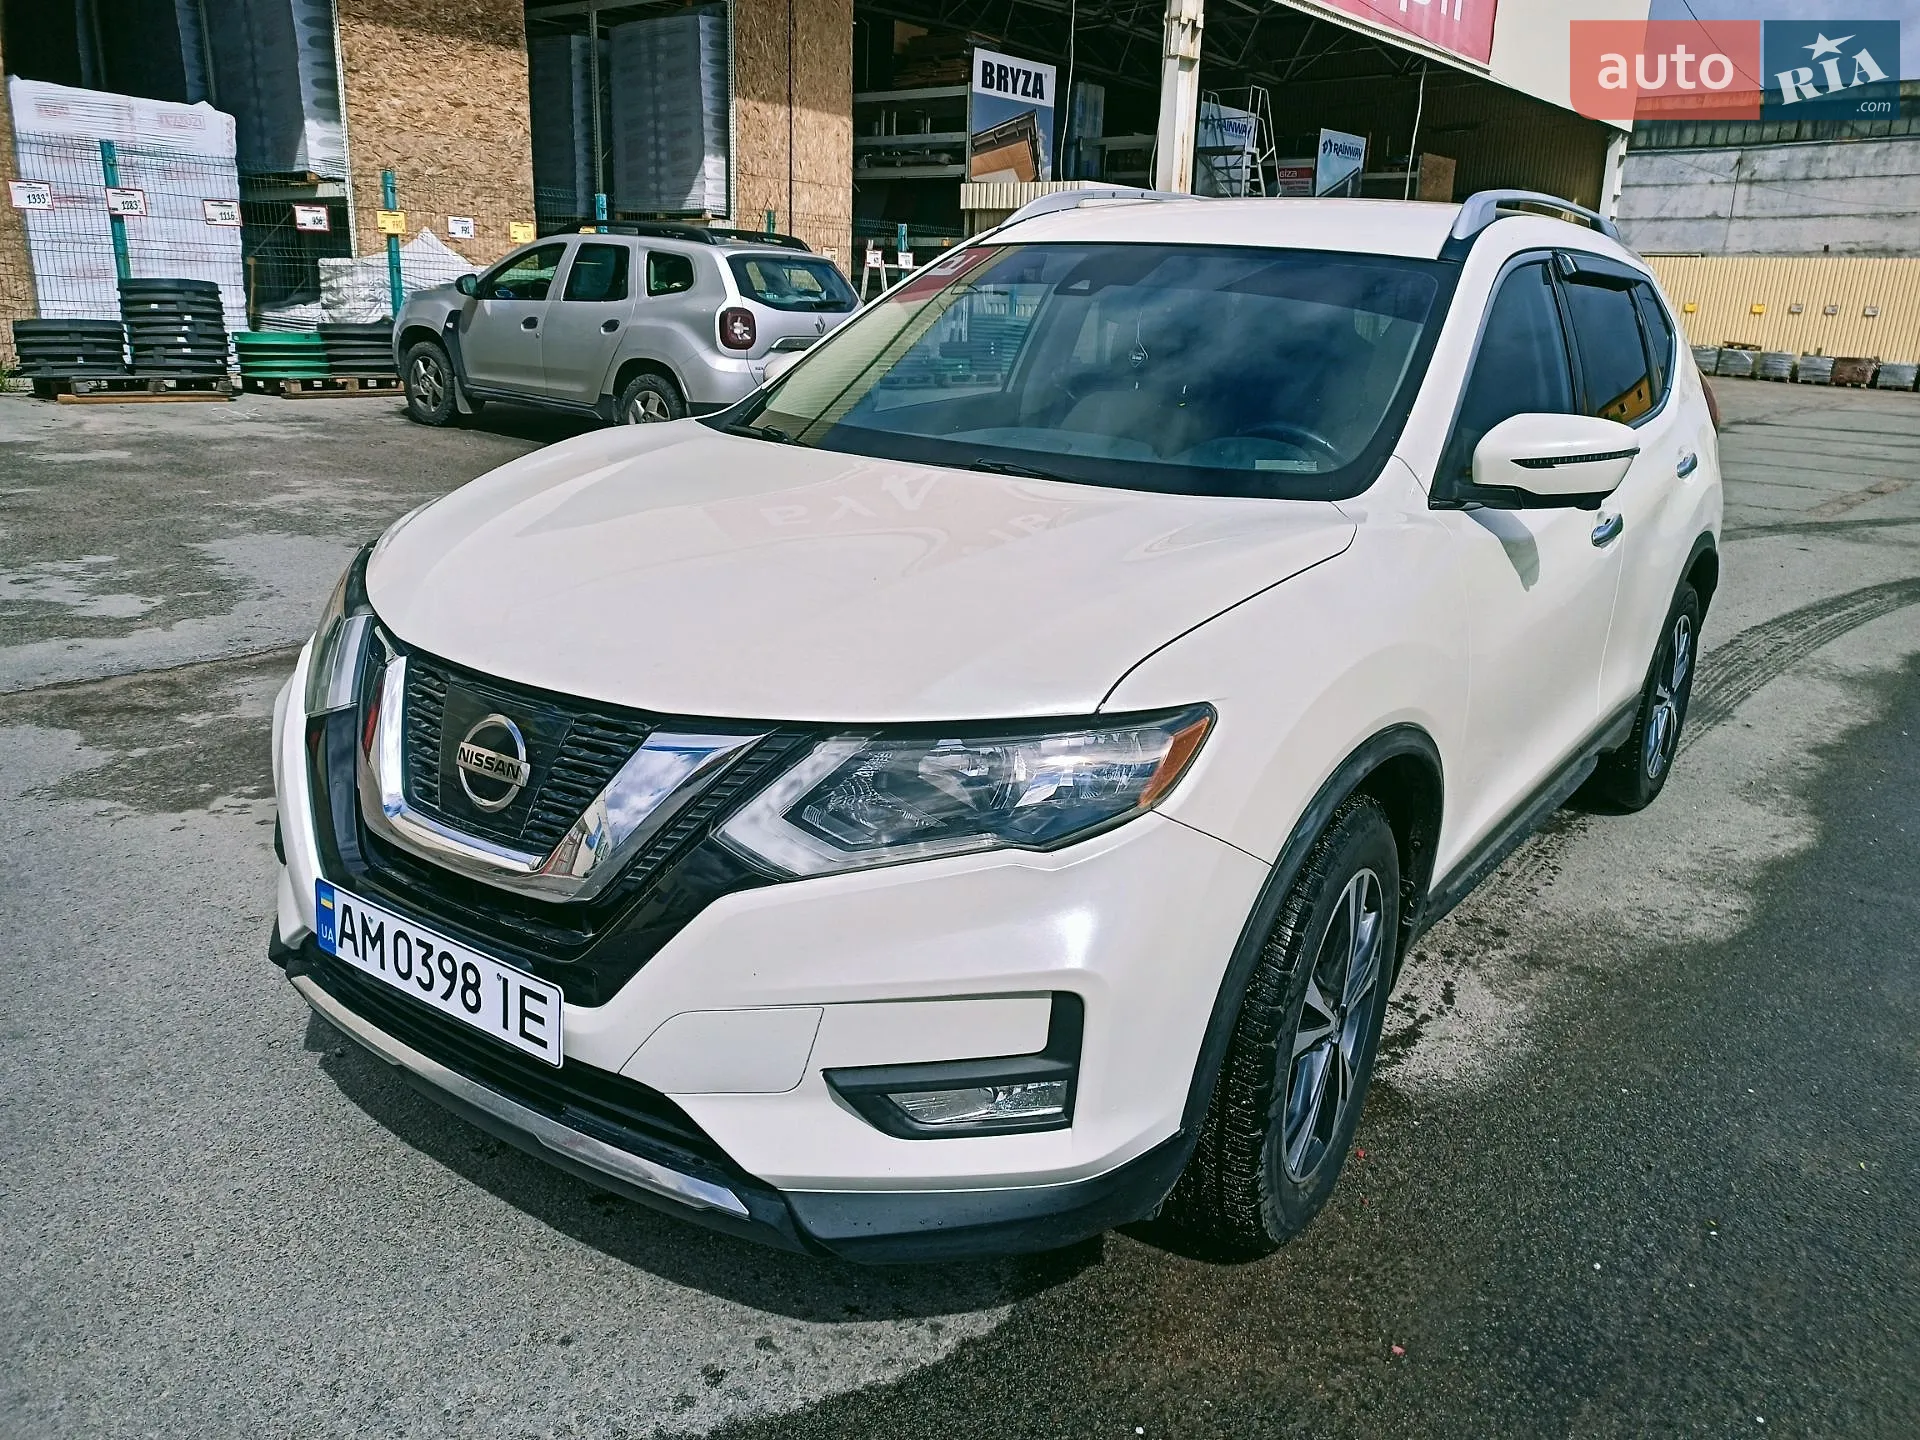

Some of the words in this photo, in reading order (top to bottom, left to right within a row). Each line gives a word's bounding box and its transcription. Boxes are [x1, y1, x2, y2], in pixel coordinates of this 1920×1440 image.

[981, 60, 1045, 100] BRYZA
[27, 193, 46, 204] 1333
[458, 747, 521, 780] NISSAN
[321, 923, 334, 944] UA
[502, 976, 548, 1050] IE
